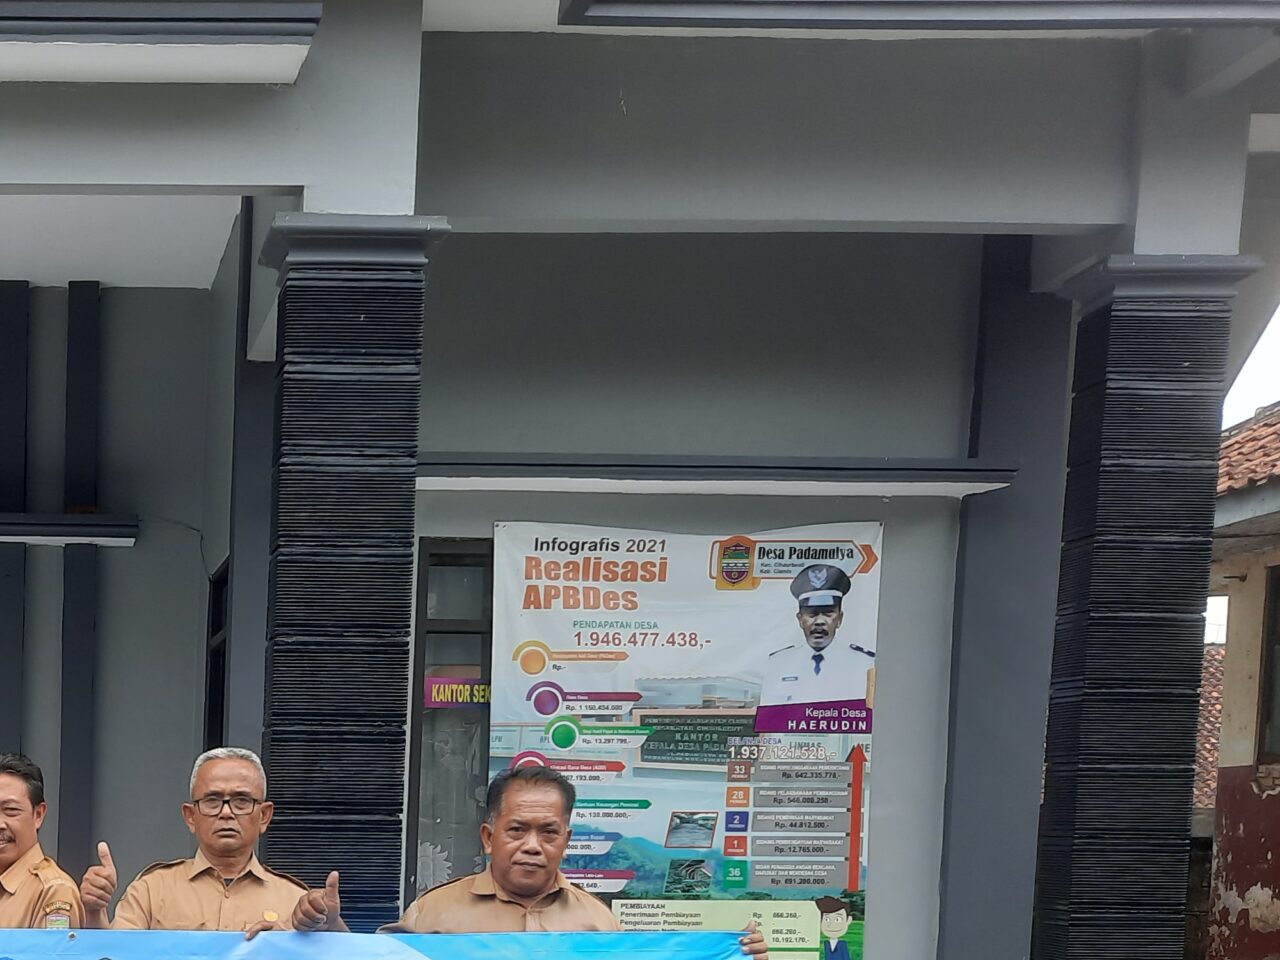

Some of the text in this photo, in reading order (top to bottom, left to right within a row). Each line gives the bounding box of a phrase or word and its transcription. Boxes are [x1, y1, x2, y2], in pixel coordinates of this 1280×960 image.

[534, 537, 667, 555] Infografis 2021
[757, 546, 854, 561] Desa Padamulya
[524, 556, 669, 583] Realisasi
[521, 584, 640, 611] APBDes
[573, 620, 659, 630] PENDAPATAN DESA
[574, 631, 712, 650] 1.946.477.438,-
[431, 683, 490, 704] KANTOR SEK
[805, 707, 867, 719] Kepala Desa
[787, 720, 867, 731] HAERUDIN
[674, 733, 719, 742] KANTOR
[763, 737, 782, 745] DESA
[727, 745, 837, 762] 1.937.121.528,-
[734, 765, 746, 775] 33
[732, 791, 744, 799] 28
[733, 815, 740, 824] 2
[732, 839, 738, 848] 1
[729, 868, 741, 876] 36
